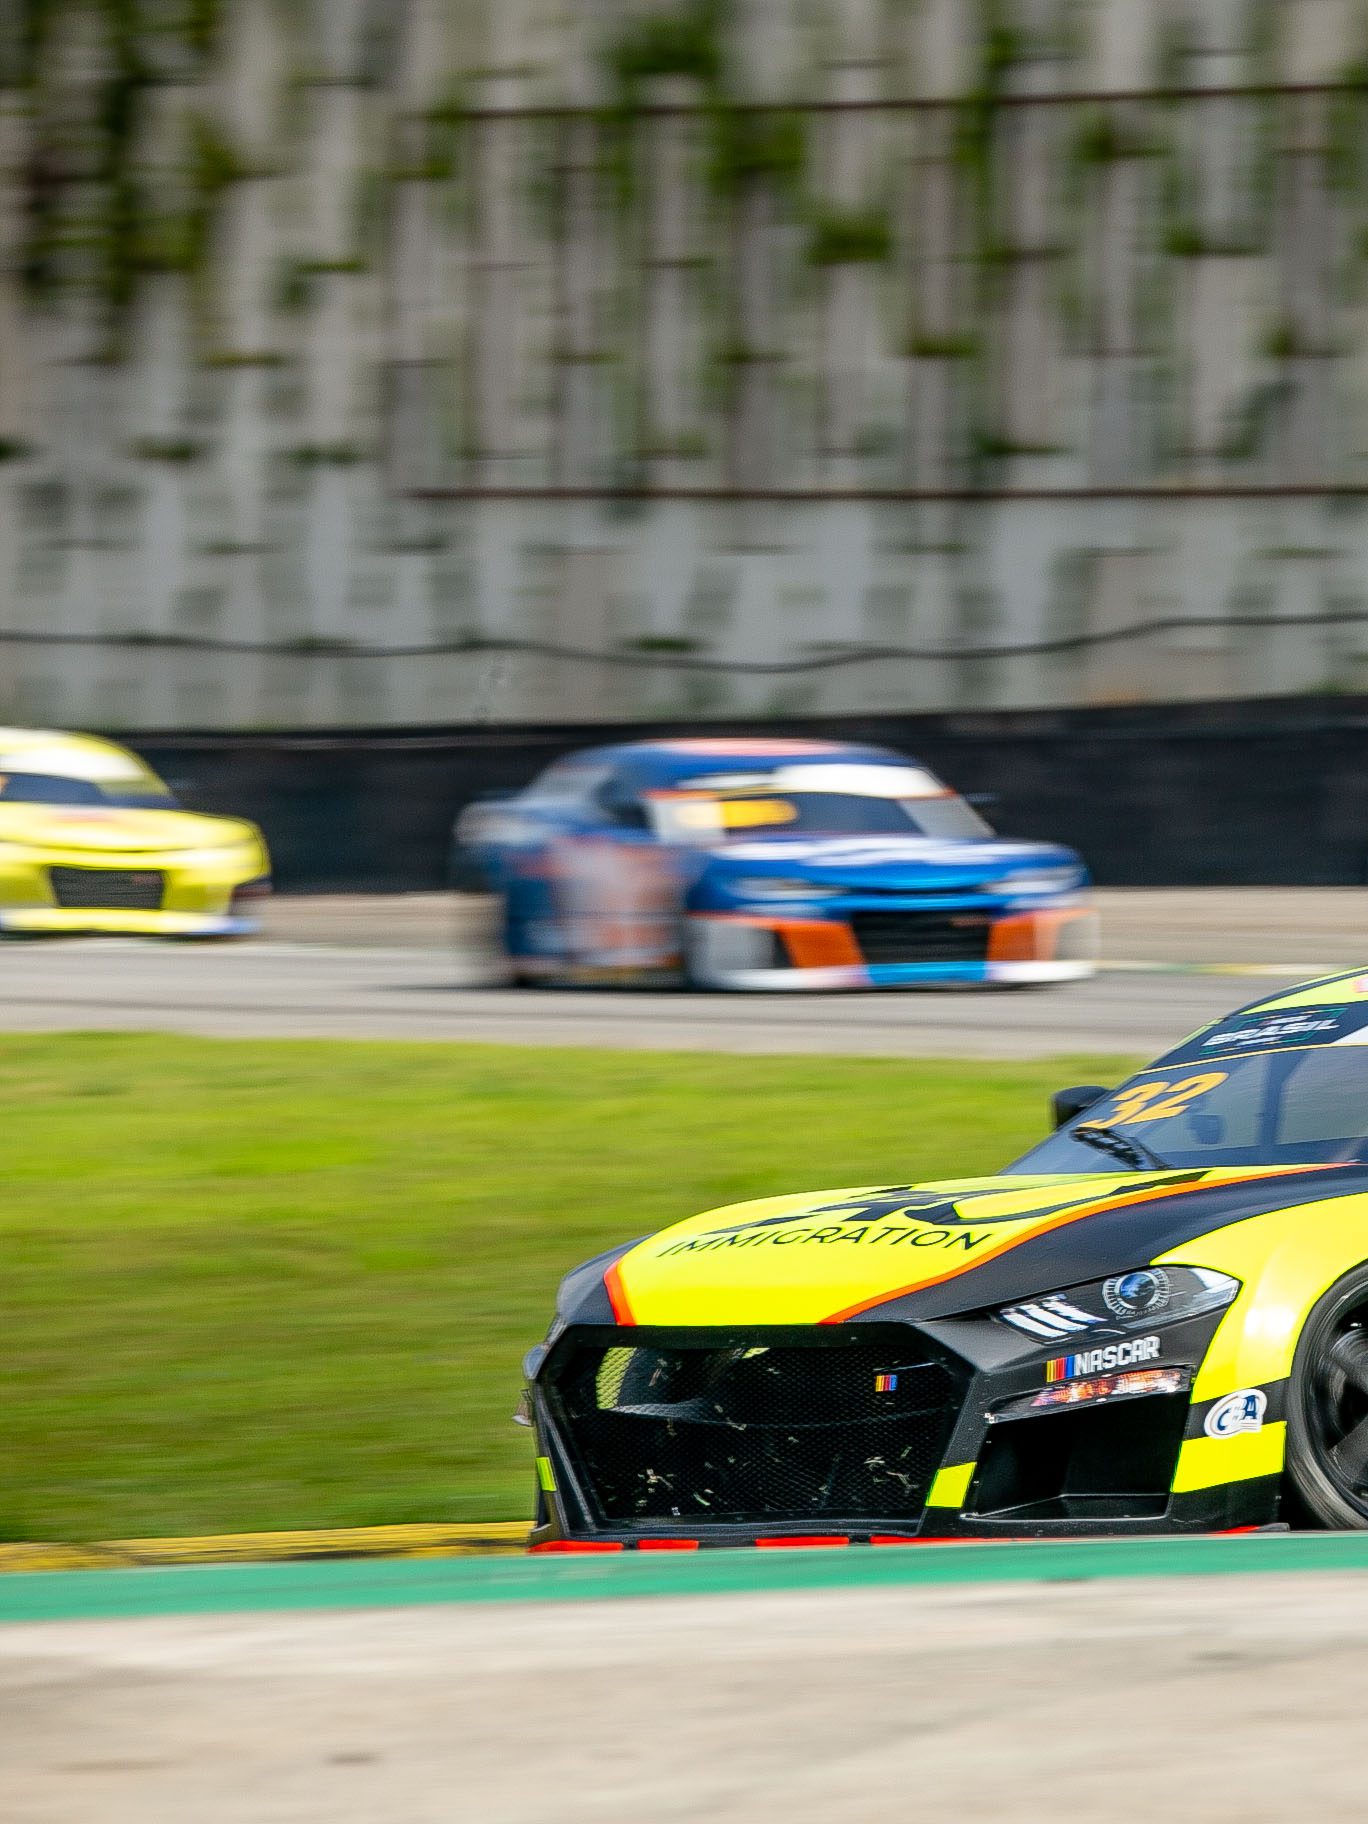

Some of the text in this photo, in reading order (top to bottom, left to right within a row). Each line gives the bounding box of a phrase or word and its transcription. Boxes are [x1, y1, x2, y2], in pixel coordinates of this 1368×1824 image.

[1076, 1072, 1230, 1129] 32
[656, 1226, 992, 1258] IMMIGRATION
[1073, 1335, 1161, 1376] NASCAR
